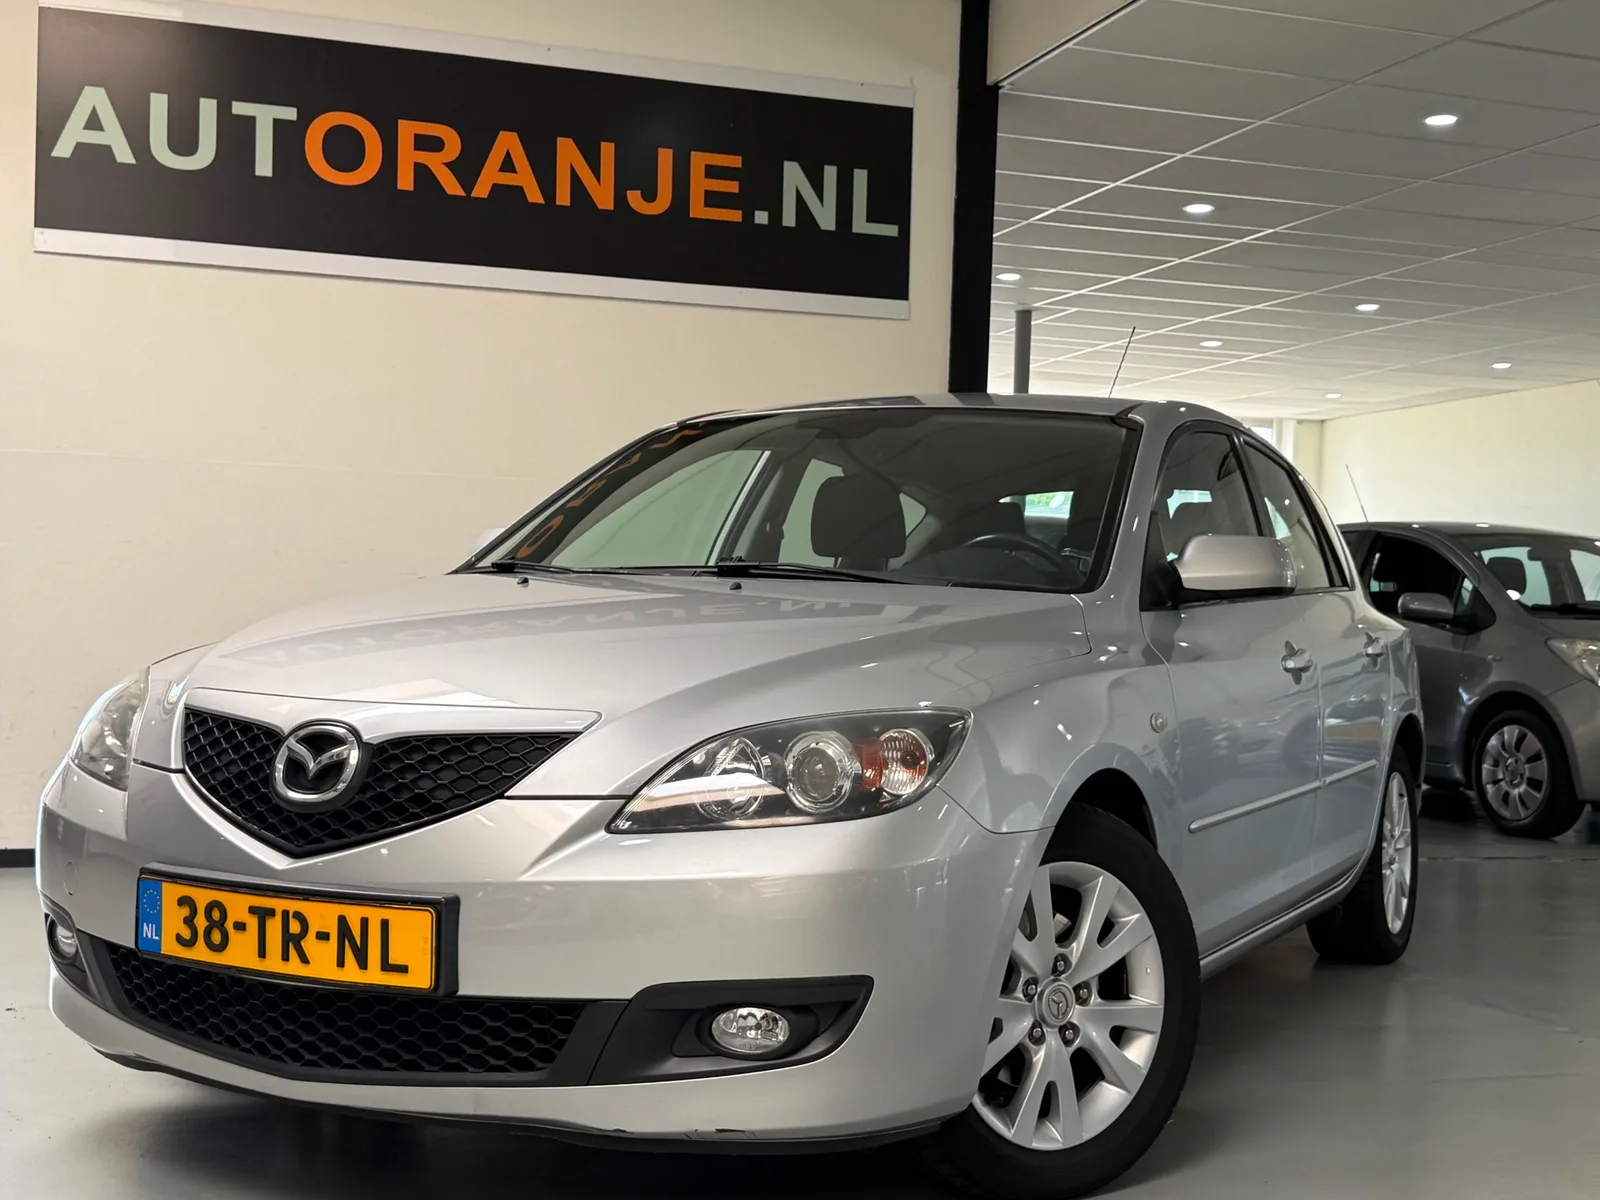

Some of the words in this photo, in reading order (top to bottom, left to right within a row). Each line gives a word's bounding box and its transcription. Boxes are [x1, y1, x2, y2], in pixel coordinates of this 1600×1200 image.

[50, 85, 900, 238] AUTORANJE.NL
[143, 922, 160, 941] NL
[175, 895, 409, 974] 38-TR-NL
